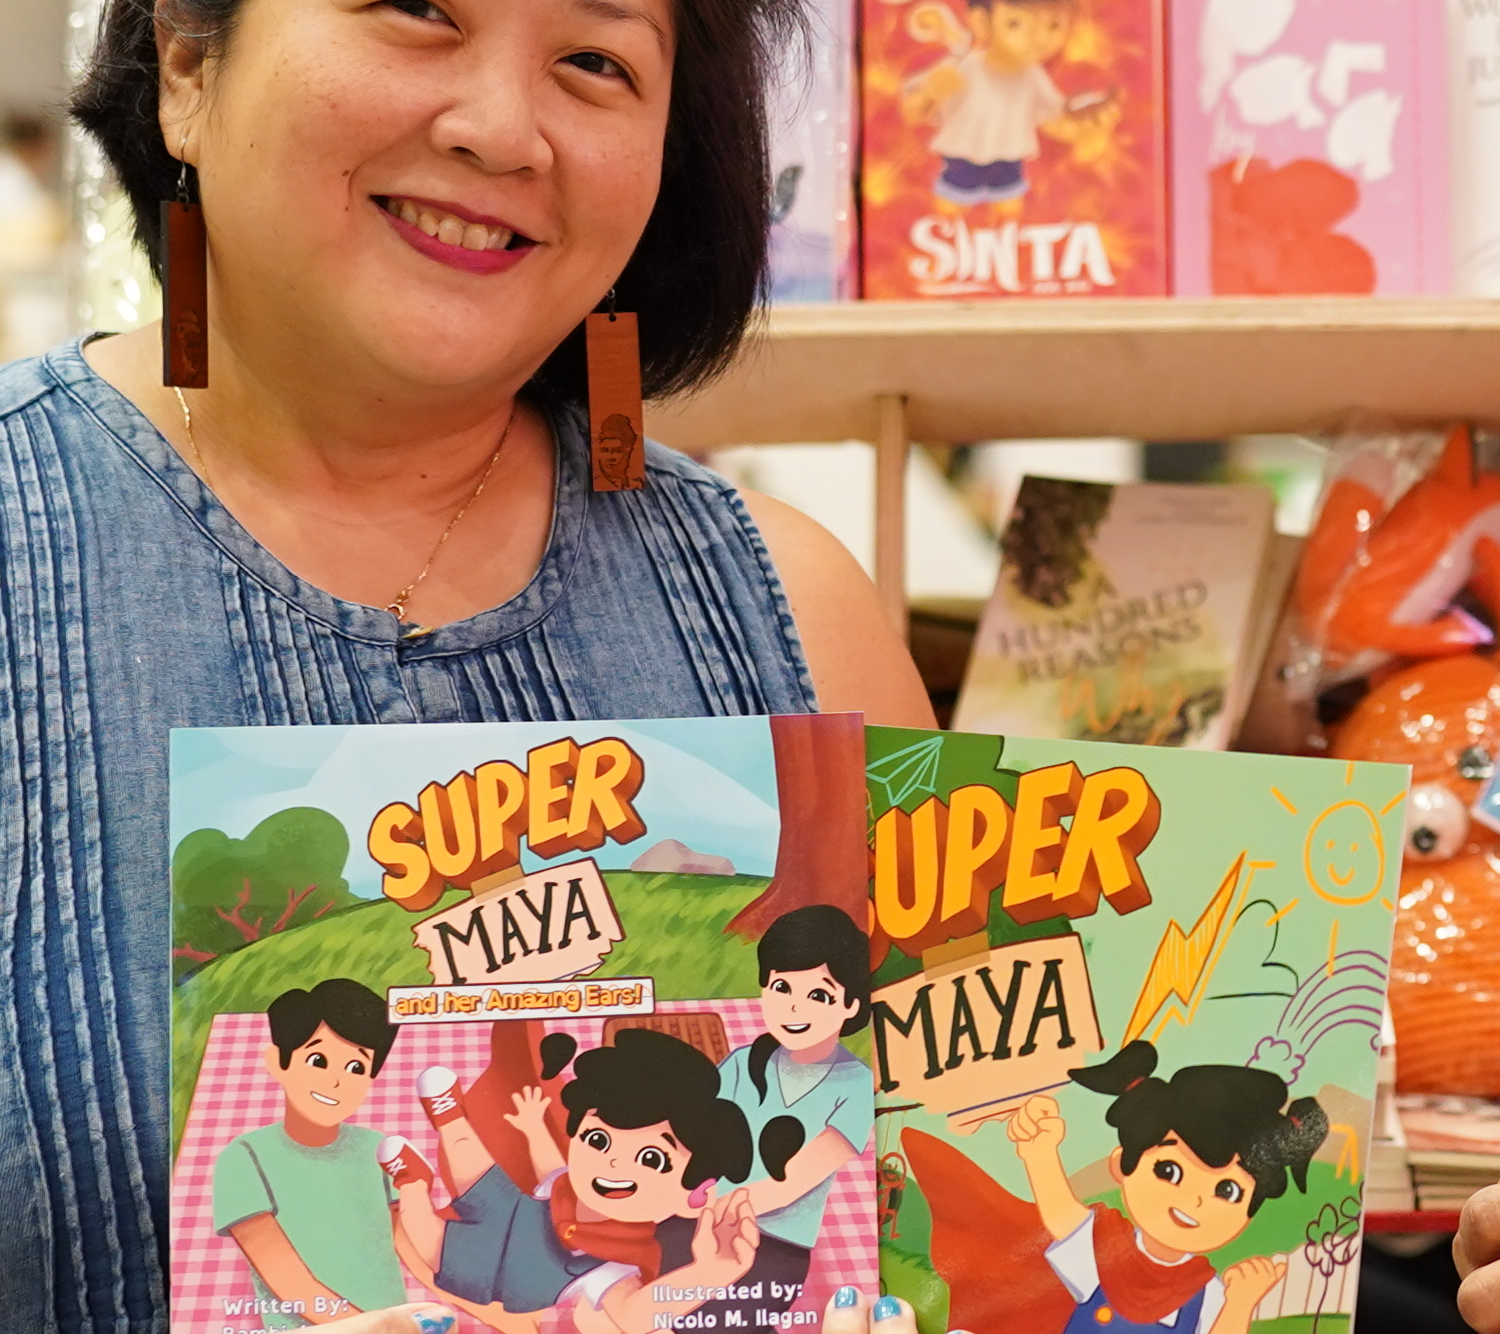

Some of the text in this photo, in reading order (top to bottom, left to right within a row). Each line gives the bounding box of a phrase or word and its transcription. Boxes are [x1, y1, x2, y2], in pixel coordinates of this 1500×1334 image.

[909, 216, 1116, 293] SINTA
[997, 578, 1208, 661] HUNDRED
[1017, 619, 1204, 688] REASONS
[368, 738, 646, 911] SUPER
[868, 762, 1160, 947] UPER
[433, 877, 602, 984] MAYA
[395, 984, 643, 1015] and her Amazing Ears!
[873, 958, 1077, 1092] MAYA
[222, 1296, 349, 1317] Written By:
[652, 1281, 804, 1304] Illustrated by:
[652, 1307, 819, 1331] Nicolo M. Ilagan
